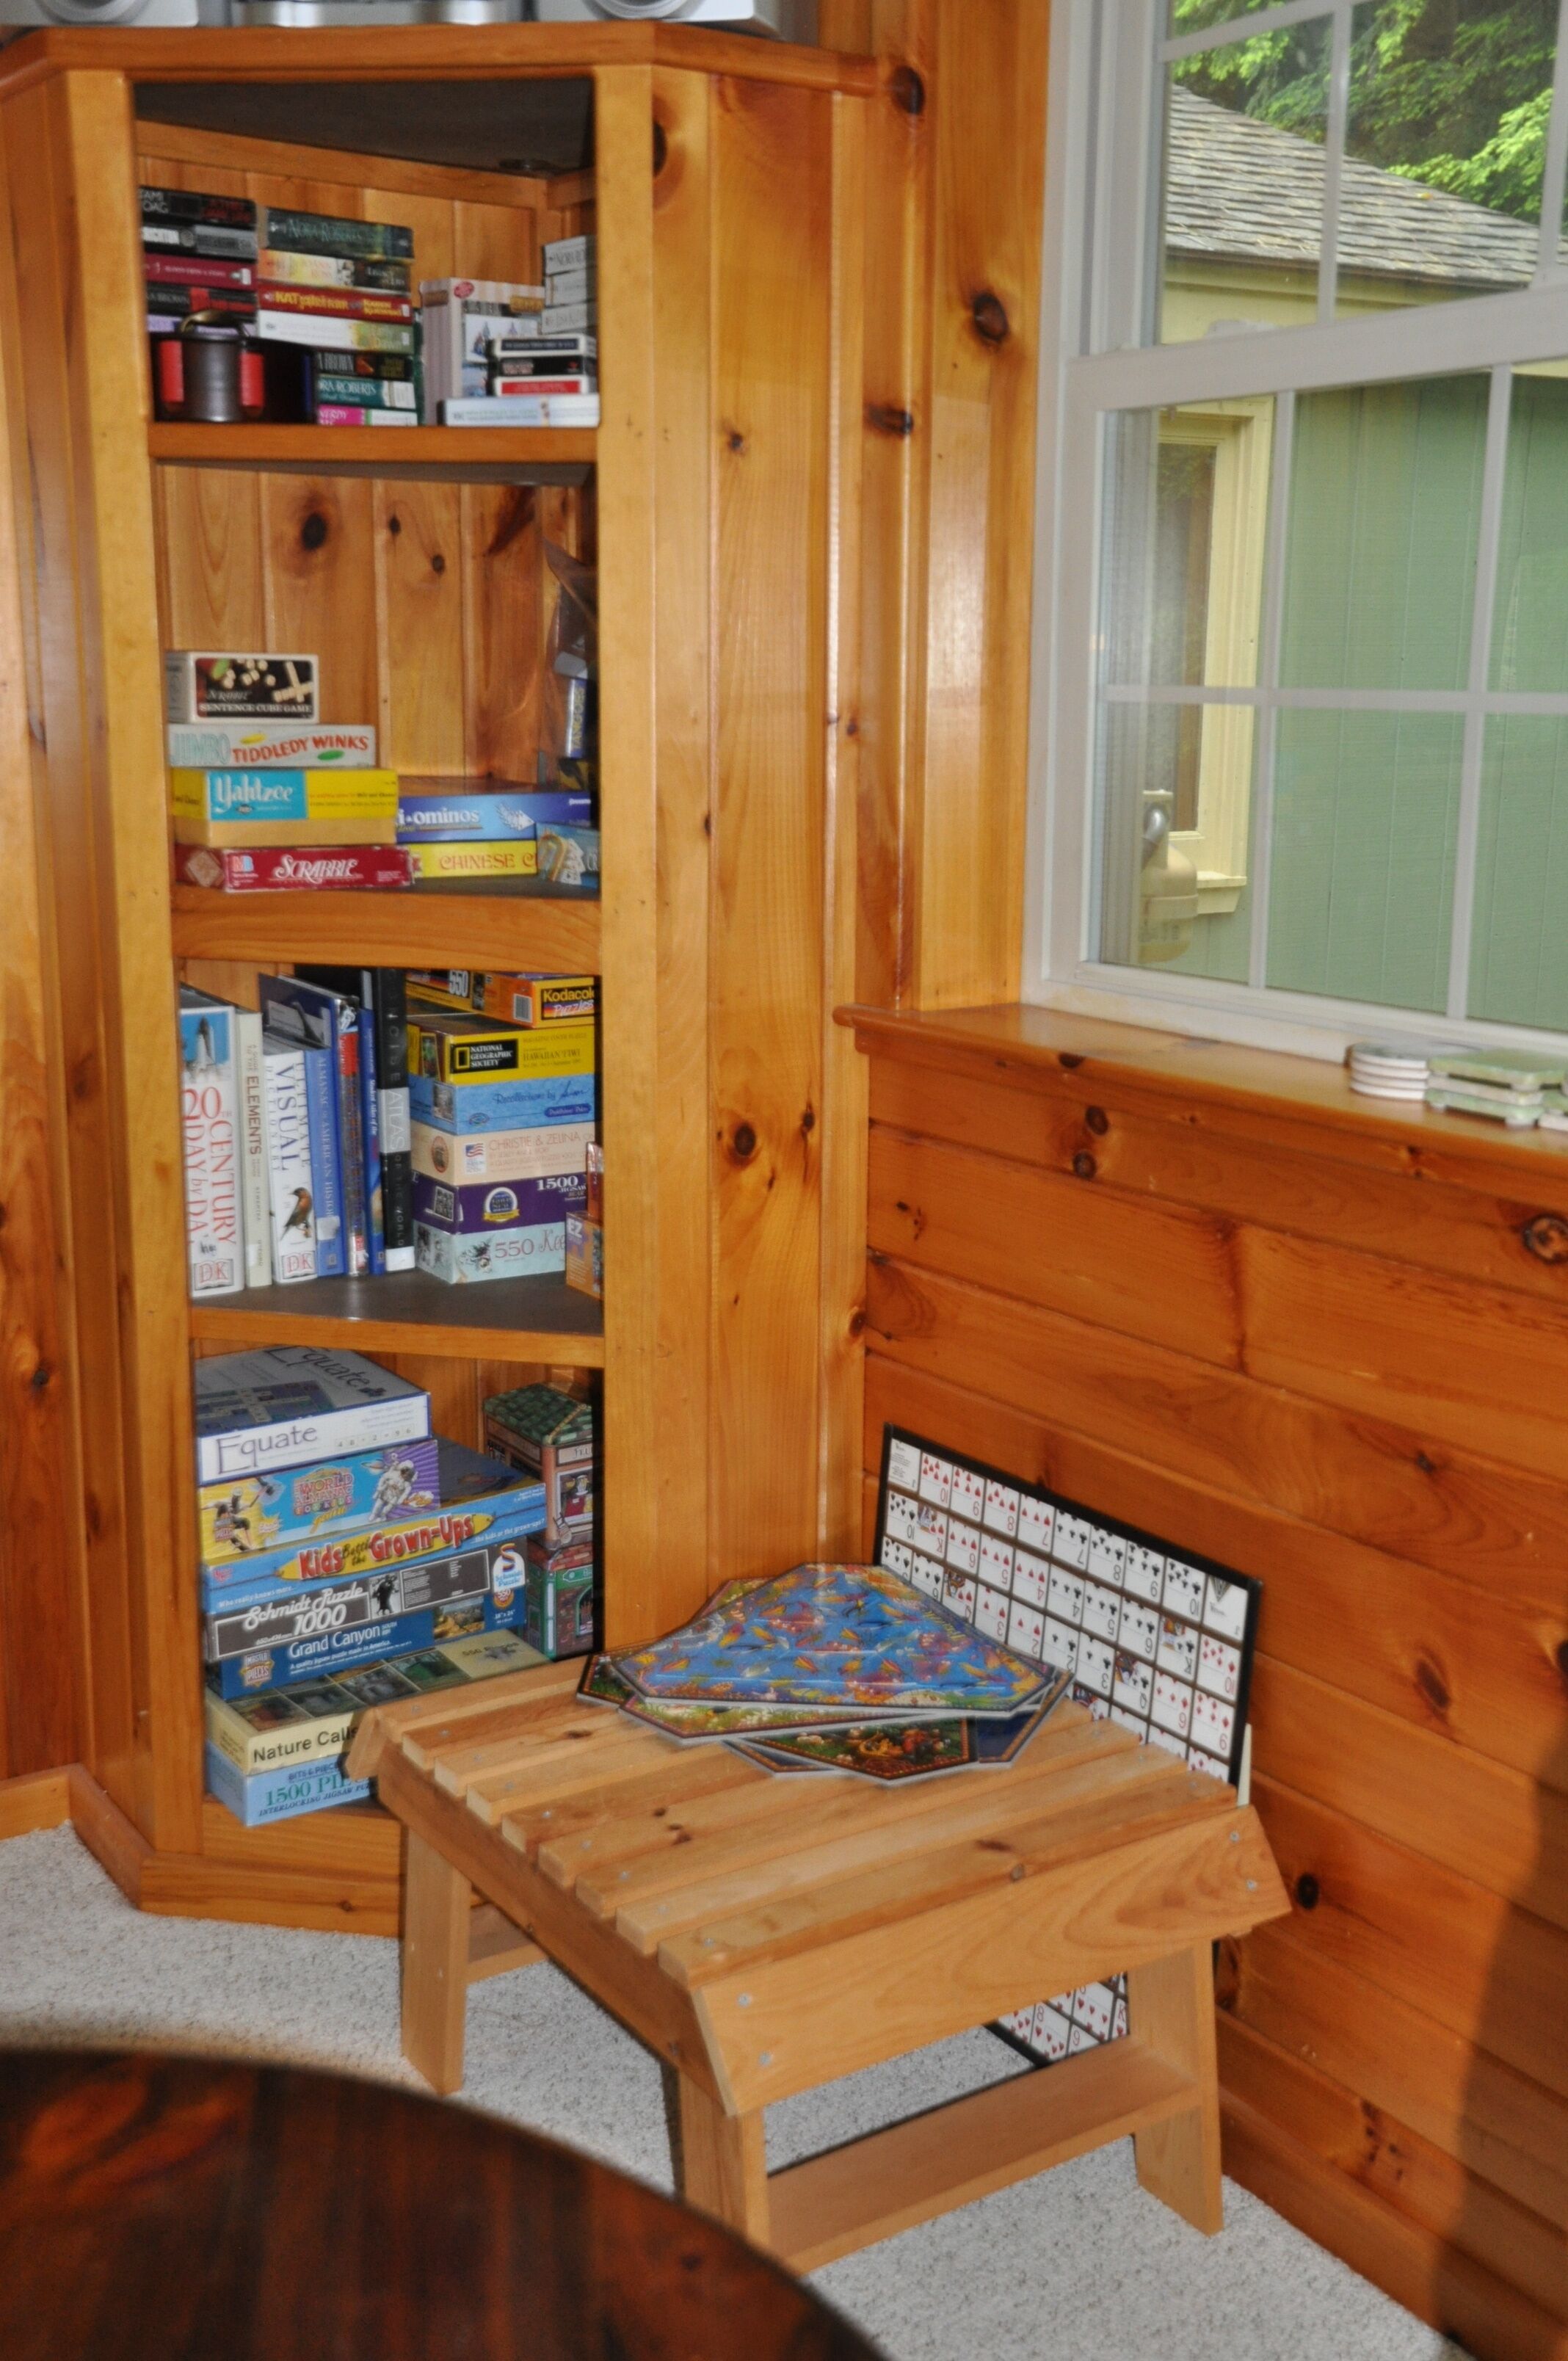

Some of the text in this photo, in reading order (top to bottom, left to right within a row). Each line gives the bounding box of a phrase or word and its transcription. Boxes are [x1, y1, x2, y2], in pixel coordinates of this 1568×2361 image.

[199, 703, 313, 714] SENTENCE CUBE GAME
[232, 735, 369, 764] TIDDLEDY WINKS
[214, 773, 293, 814] Yahtzee
[273, 854, 359, 882] SCRABBLE
[440, 853, 515, 871] CHINESE
[449, 970, 469, 998] 550
[470, 1044, 504, 1053] NATIONAL
[470, 1051, 513, 1061] GEOGRAPHIC
[470, 1059, 500, 1068] SOCIETY
[317, 1056, 329, 1106] ALMANAC
[246, 1076, 261, 1156] ELEMENTS
[265, 1065, 280, 1172] DICTIONARY
[275, 1066, 299, 1171] VISUAL
[389, 1090, 407, 1151] ATLAS
[184, 1119, 206, 1172] DAY
[321, 1121, 333, 1178] AMERICAN
[488, 1136, 532, 1151] CHRISTIE
[535, 1135, 545, 1147] &
[189, 1177, 206, 1196] by
[208, 1120, 236, 1246] CENTURY
[537, 1175, 578, 1192] 1500
[567, 1217, 583, 1238] EZ
[494, 1238, 534, 1259] 550
[286, 1252, 314, 1274] DK
[197, 1261, 229, 1284] DK
[215, 1425, 318, 1475] Equate
[299, 1473, 354, 1493] WORLD
[940, 1487, 949, 1504] 10
[972, 1501, 980, 1517] 9
[907, 1524, 915, 1540] 10
[1006, 1515, 1015, 1531] 8
[369, 1512, 474, 1561] Grown-Ups
[936, 1537, 944, 1553] K
[1042, 1531, 1049, 1547] 7
[297, 1542, 344, 1580] Kids
[969, 1553, 976, 1568] 6
[1076, 1548, 1084, 1565] 7
[1001, 1569, 1009, 1584] 5
[1113, 1564, 1122, 1581] 8
[1037, 1586, 1045, 1601] 4
[1150, 1581, 1158, 1597] 9
[243, 1595, 311, 1631] Schmidt
[311, 1581, 364, 1613] Puzzle
[1072, 1602, 1081, 1617] 4
[1189, 1597, 1199, 1616] 10
[292, 1603, 347, 1636] 1000
[996, 1620, 1004, 1636] 3
[1107, 1619, 1116, 1636] 5
[288, 1639, 330, 1658] Grand
[332, 1625, 382, 1649] Canyon
[1031, 1639, 1039, 1655] 2
[1144, 1637, 1153, 1654] 6
[296, 1660, 313, 1670] quality
[314, 1655, 331, 1665] jigsaw
[332, 1651, 348, 1661] puzzle
[349, 1647, 363, 1655] made
[1065, 1655, 1075, 1670] 2
[1183, 1656, 1193, 1675] K
[1101, 1672, 1109, 1689] 3
[1224, 1677, 1236, 1694] 10
[1139, 1692, 1147, 1709] Q
[1177, 1712, 1187, 1729] 6
[253, 1737, 312, 1763] Nature
[1219, 1733, 1228, 1751] 9
[258, 1786, 354, 1817] INTERLOCKING JIGSAW
[265, 1780, 312, 1807] 1500
[1037, 2005, 1045, 2022] 8
[1072, 2029, 1081, 2046] 9
